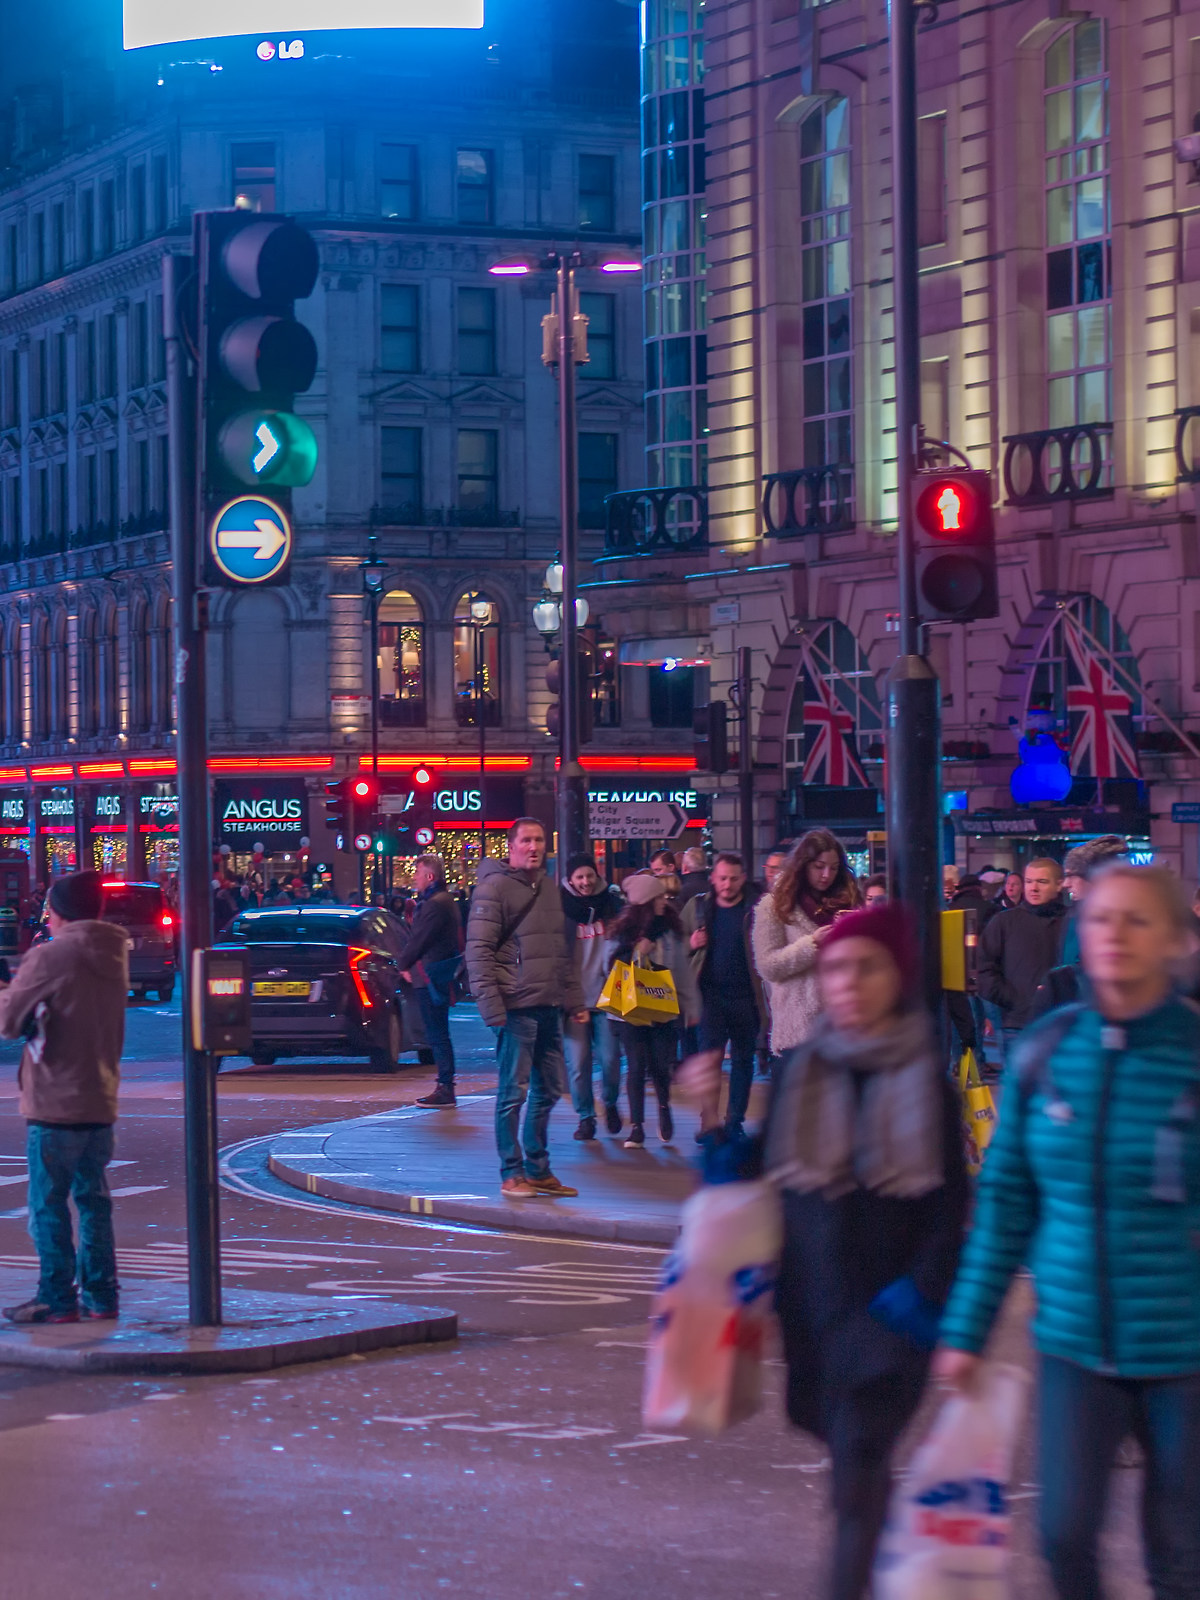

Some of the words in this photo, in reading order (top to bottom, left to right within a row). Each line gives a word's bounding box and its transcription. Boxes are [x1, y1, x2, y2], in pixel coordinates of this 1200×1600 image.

[278, 39, 304, 59] LG
[2, 799, 24, 818] ANGUS
[96, 796, 120, 816] ANGUS
[223, 799, 302, 819] ANGUS
[400, 790, 482, 812] AGUS
[598, 805, 618, 815] City
[223, 821, 302, 833] STEAKHOUSE
[625, 816, 661, 825] Square
[589, 827, 601, 835] de
[604, 827, 627, 835] Park
[630, 826, 665, 835] Corner
[208, 979, 243, 995] WAIT
